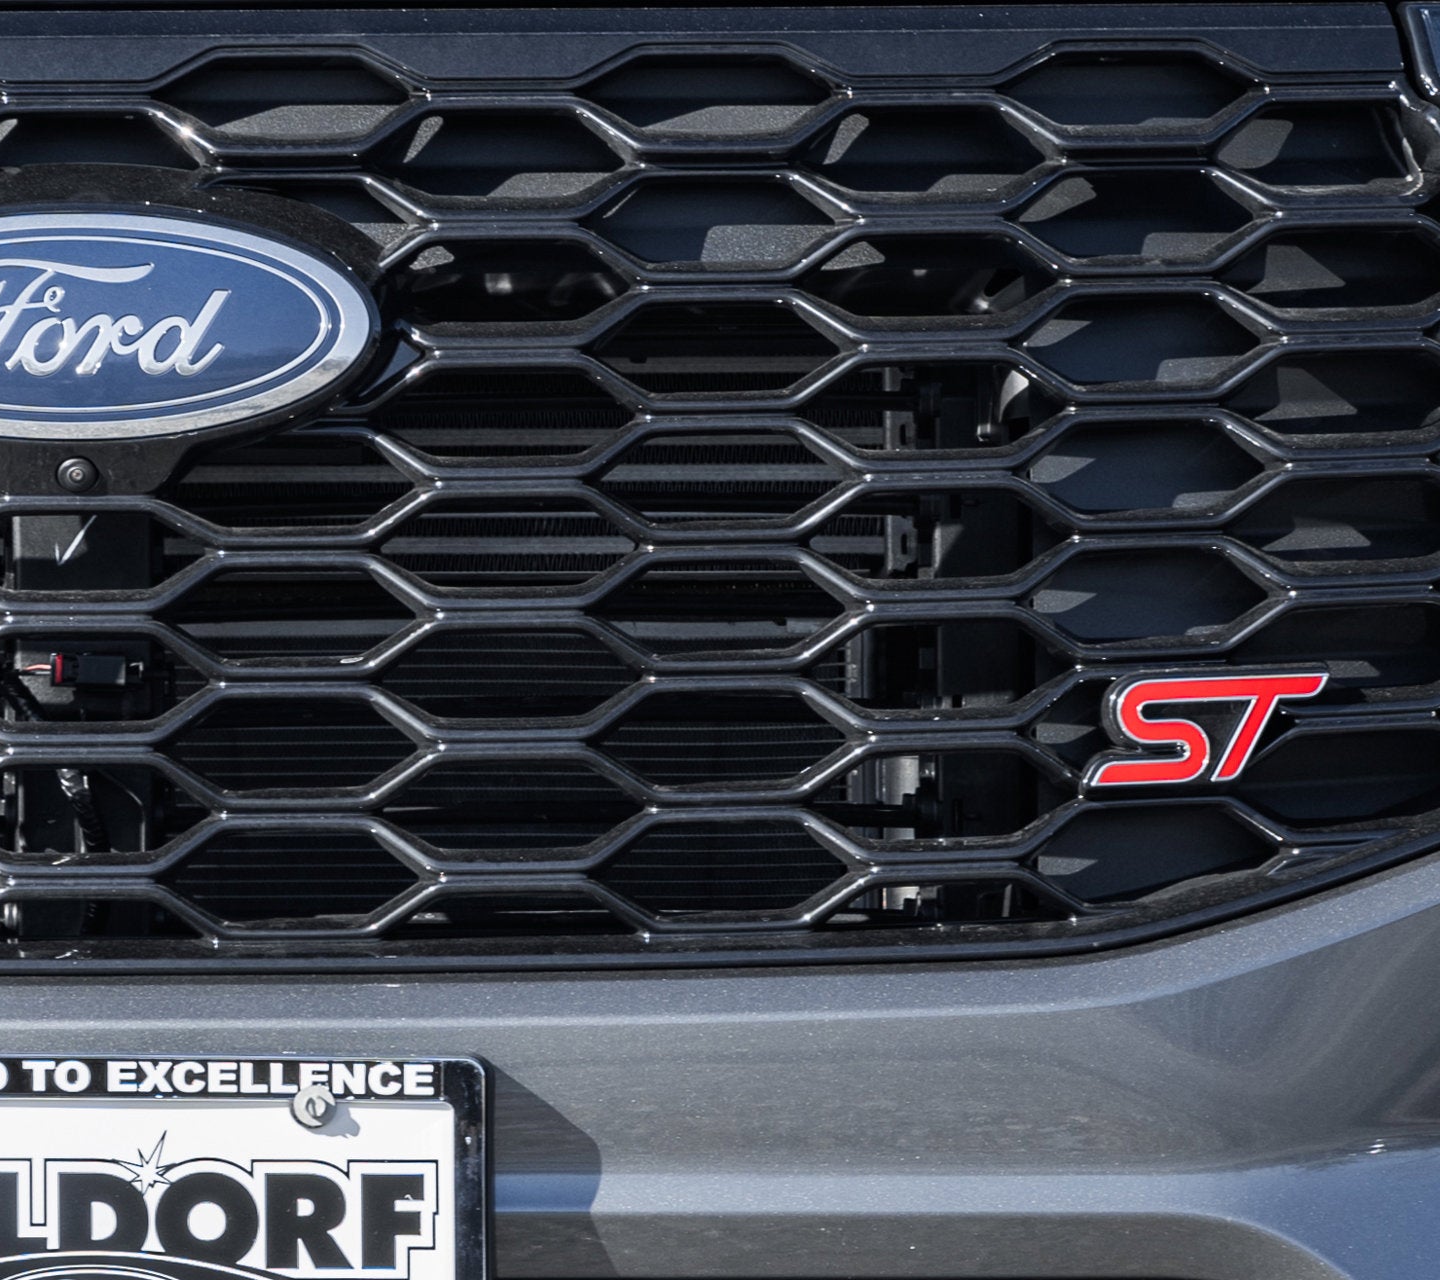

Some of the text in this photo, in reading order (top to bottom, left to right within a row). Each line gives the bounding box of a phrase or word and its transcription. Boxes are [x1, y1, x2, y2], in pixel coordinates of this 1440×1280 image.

[1091, 673, 1329, 787] ST
[22, 1061, 91, 1093] TO
[106, 1061, 435, 1095] EXCELLENCE
